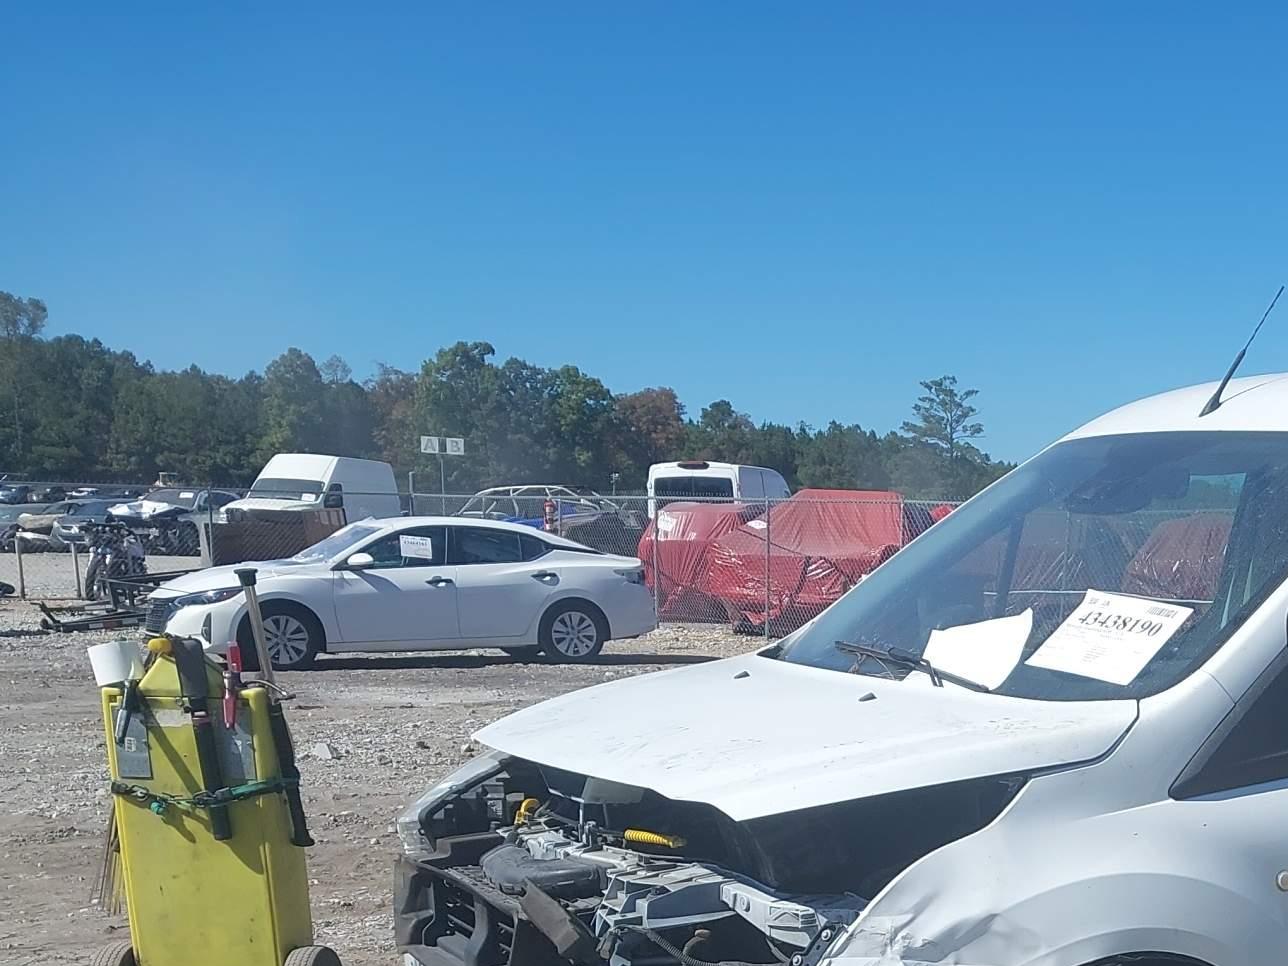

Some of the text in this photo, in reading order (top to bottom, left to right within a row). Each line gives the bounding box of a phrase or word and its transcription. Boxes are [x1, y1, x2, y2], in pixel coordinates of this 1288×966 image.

[423, 438, 436, 451] A
[450, 439, 460, 452] B
[1079, 611, 1163, 637] 43438190
